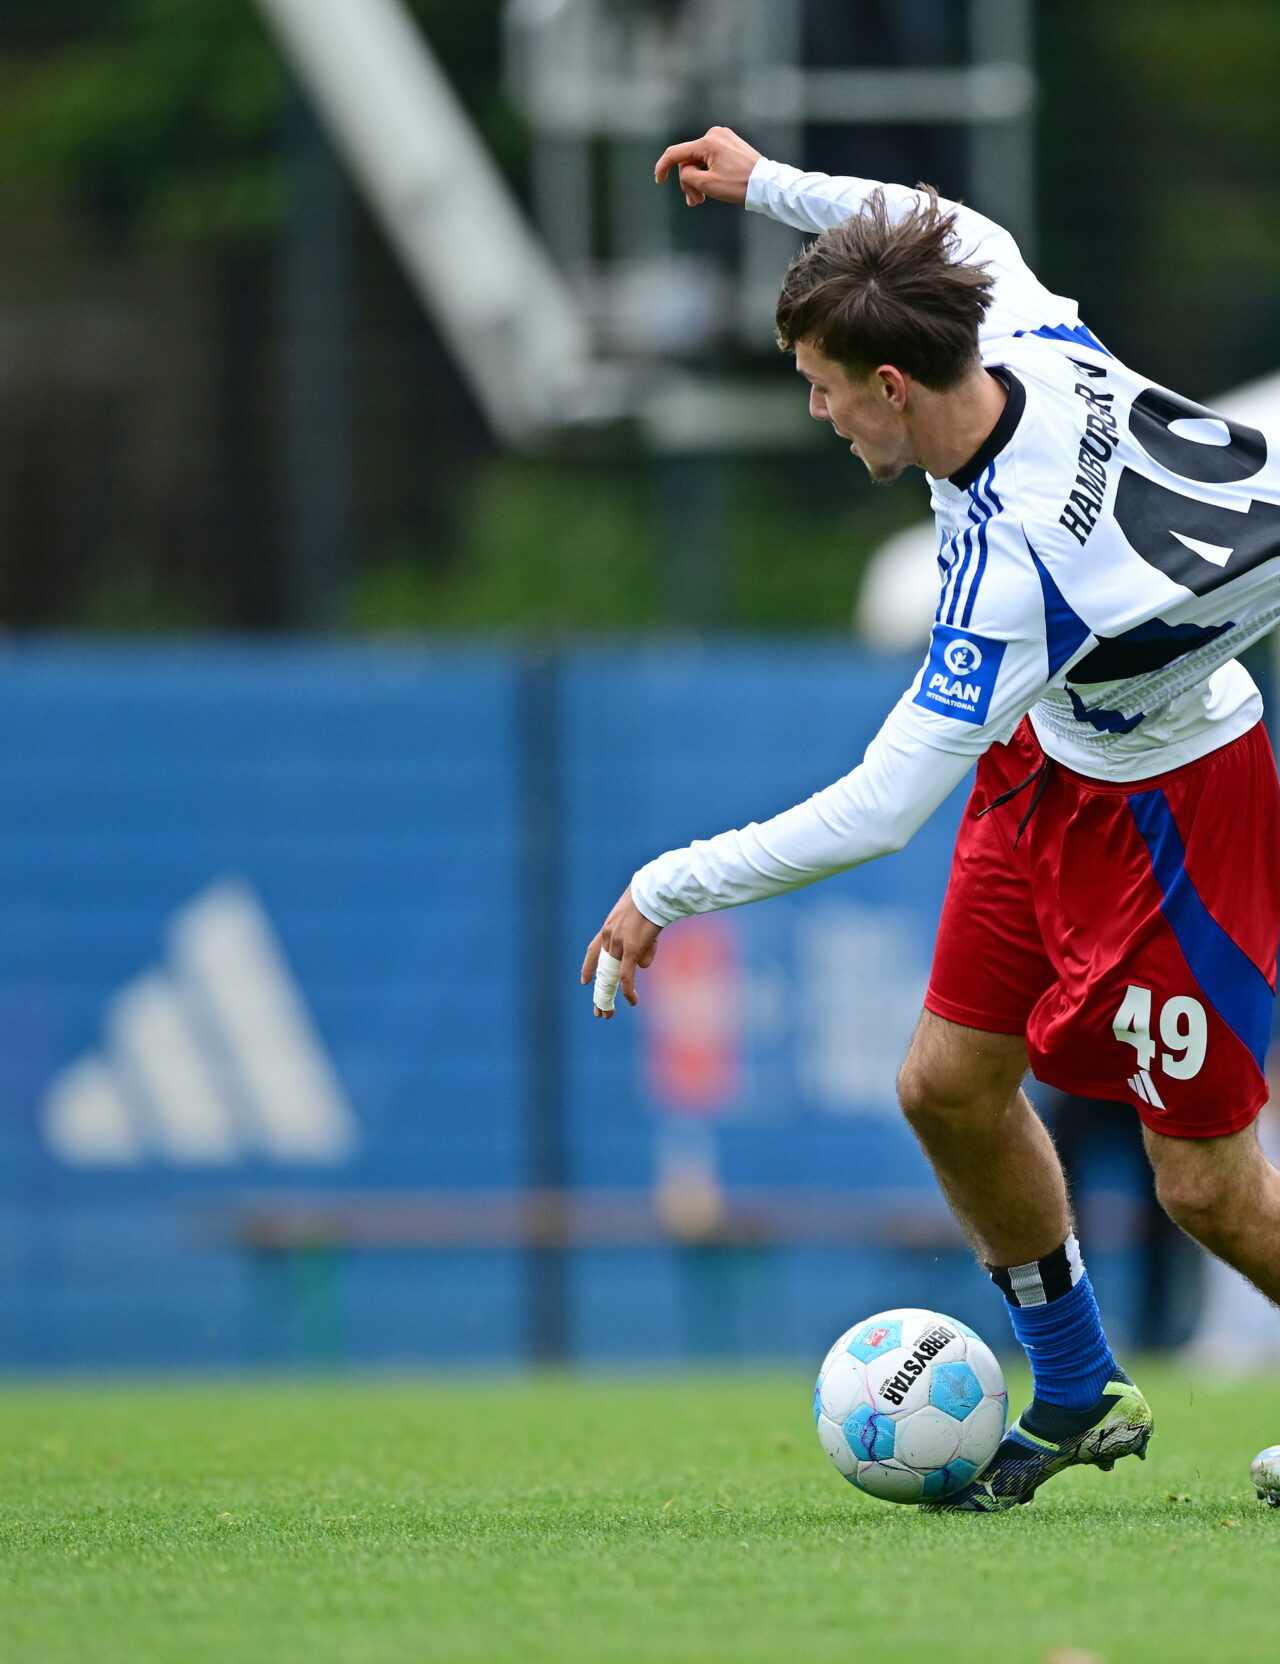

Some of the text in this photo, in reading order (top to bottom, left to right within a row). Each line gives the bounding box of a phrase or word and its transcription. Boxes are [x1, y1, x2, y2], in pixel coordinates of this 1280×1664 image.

[926, 690, 976, 712] INTERNATIONAL
[928, 672, 982, 703] PLAN
[1112, 984, 1208, 1080] 49
[883, 1325, 957, 1406] DERBYSTAR
